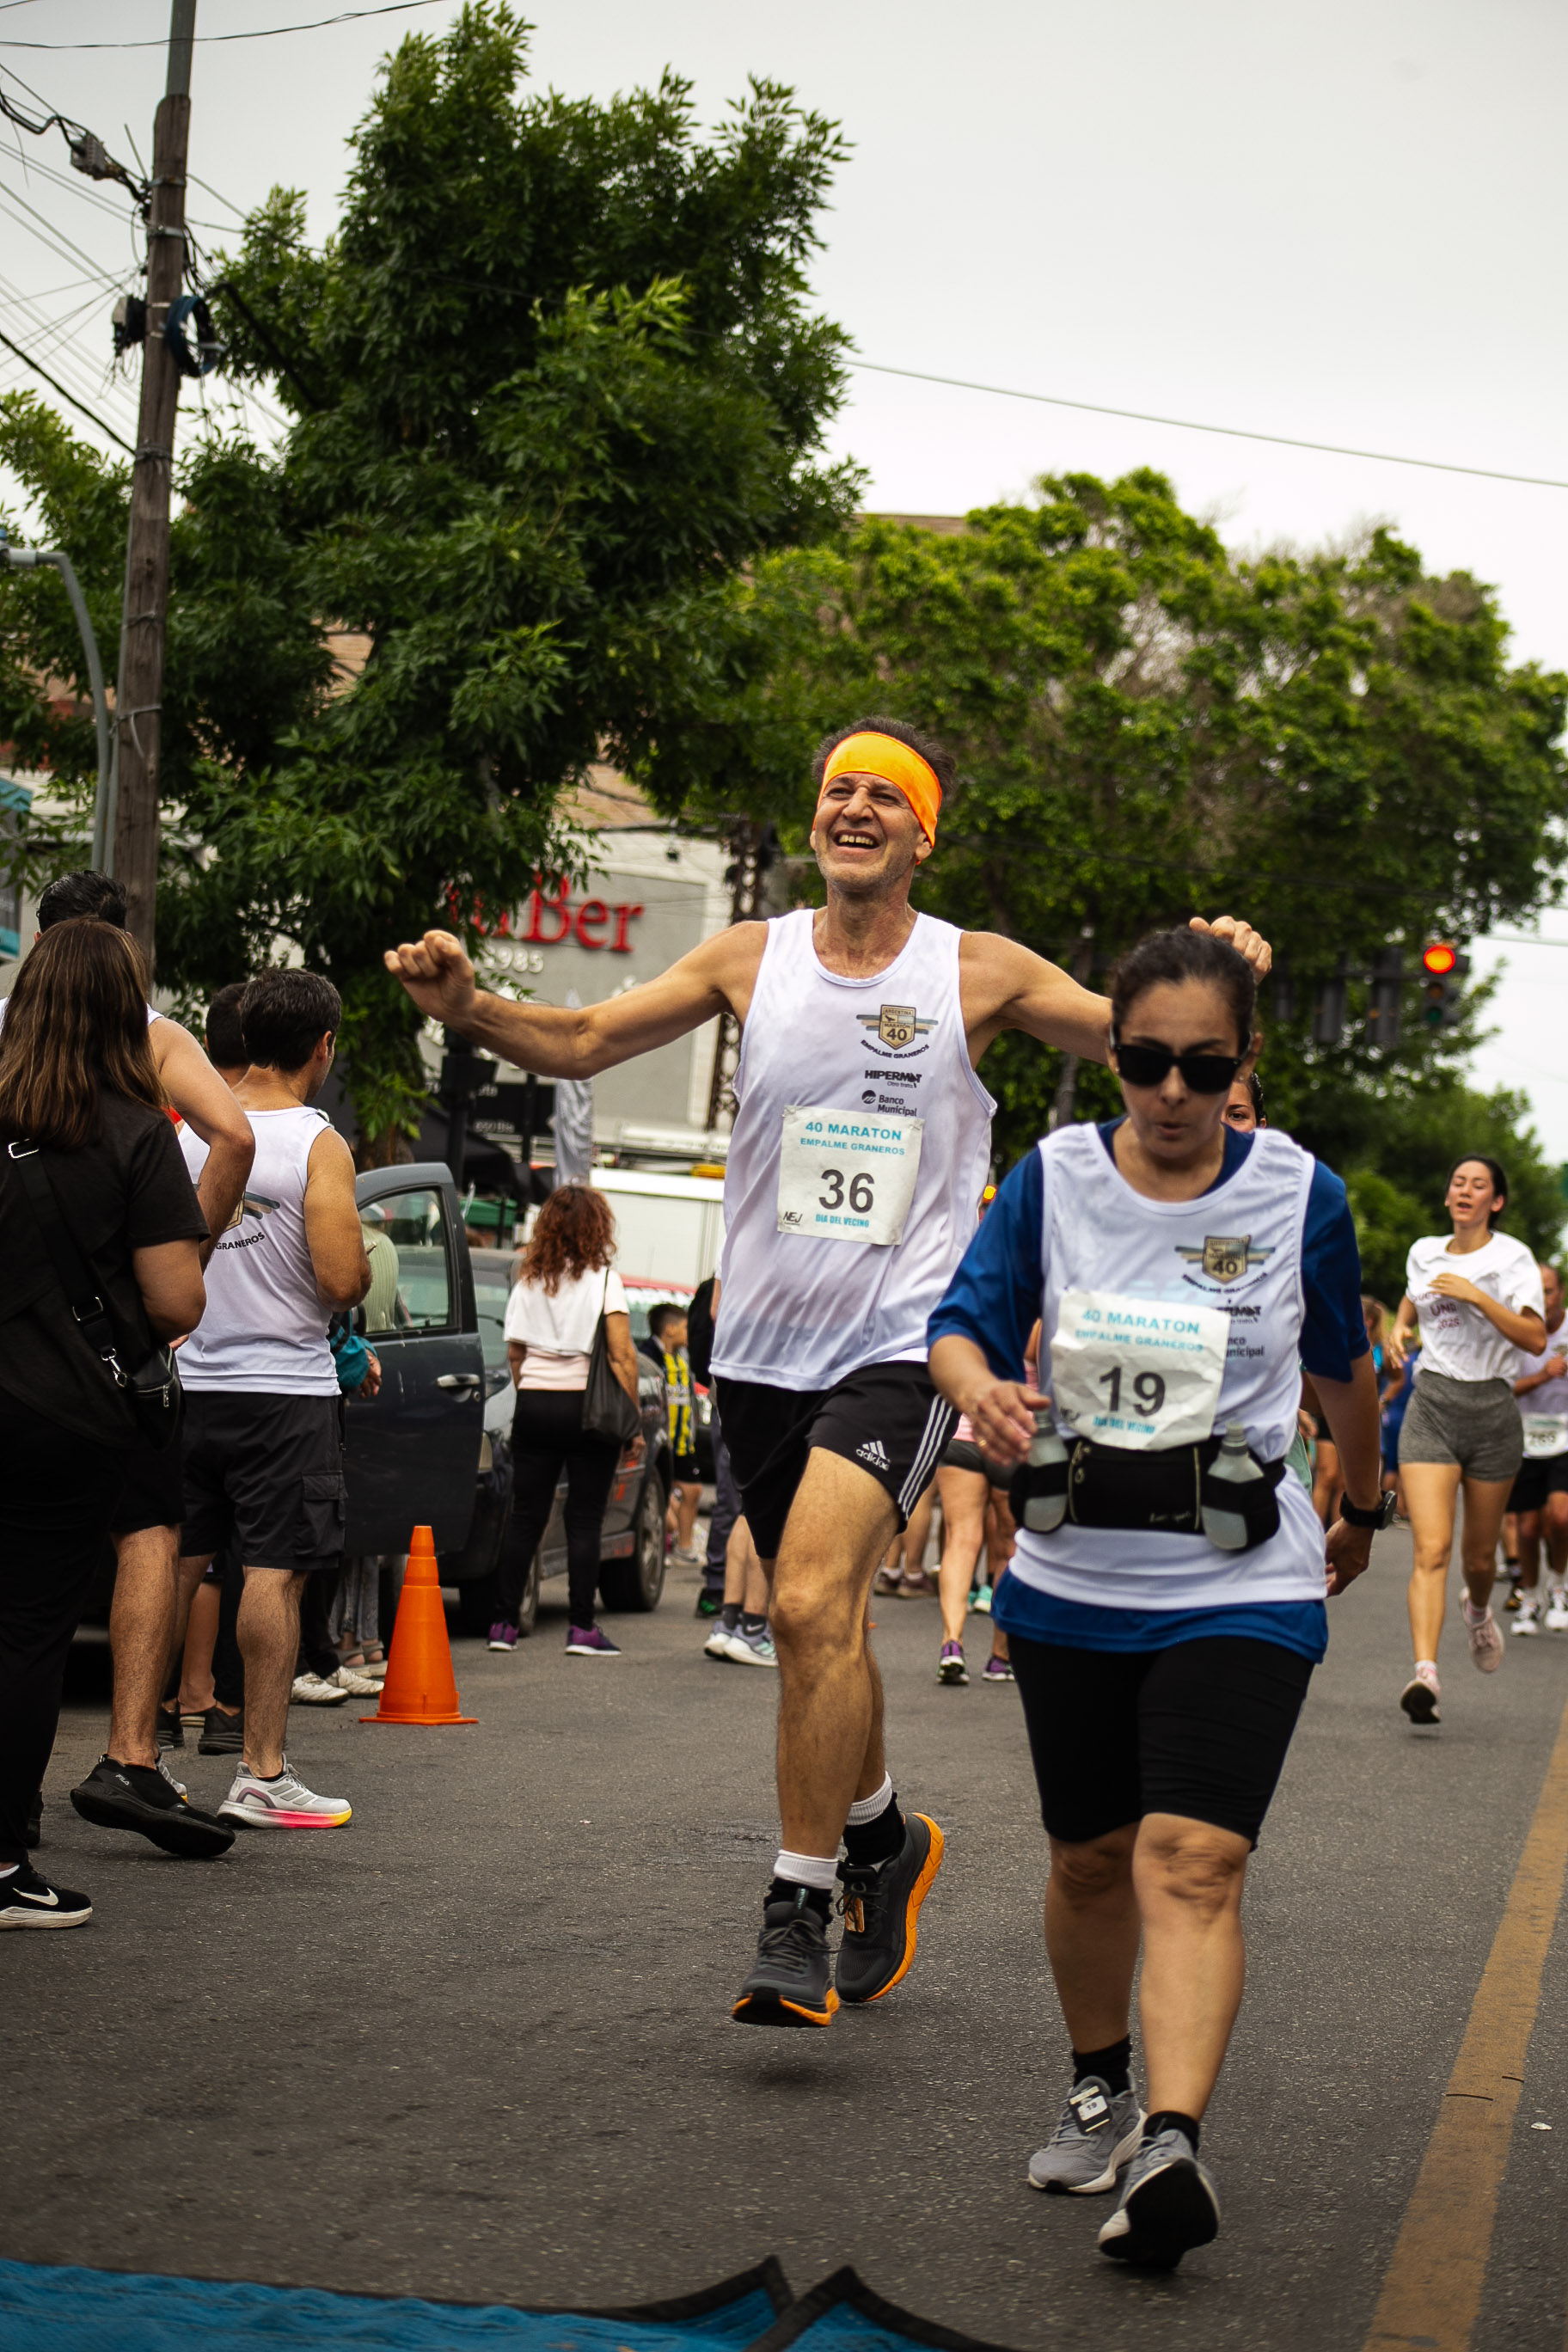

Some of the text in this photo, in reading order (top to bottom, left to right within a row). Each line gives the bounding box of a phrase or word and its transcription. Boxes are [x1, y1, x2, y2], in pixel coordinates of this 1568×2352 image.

[447, 868, 644, 953] Ber
[886, 1028, 908, 1041] 40
[861, 1039, 929, 1059] EMPALME GRANEROS
[879, 1094, 904, 1106] Banco
[877, 1104, 917, 1117] Municipal
[805, 1121, 902, 1141] 40 MARATON
[800, 1137, 905, 1155] EMPALME GRANEROS
[818, 1168, 875, 1214] 36
[815, 1213, 870, 1228] DIA DEL VECINO
[216, 1231, 266, 1250] GRANEROS
[1213, 1260, 1237, 1275] 40
[1081, 1309, 1200, 1334] 40 MARATON
[1099, 1365, 1166, 1417] 19
[855, 1449, 890, 1471] adidas
[1087, 2102, 1097, 2110] 19
